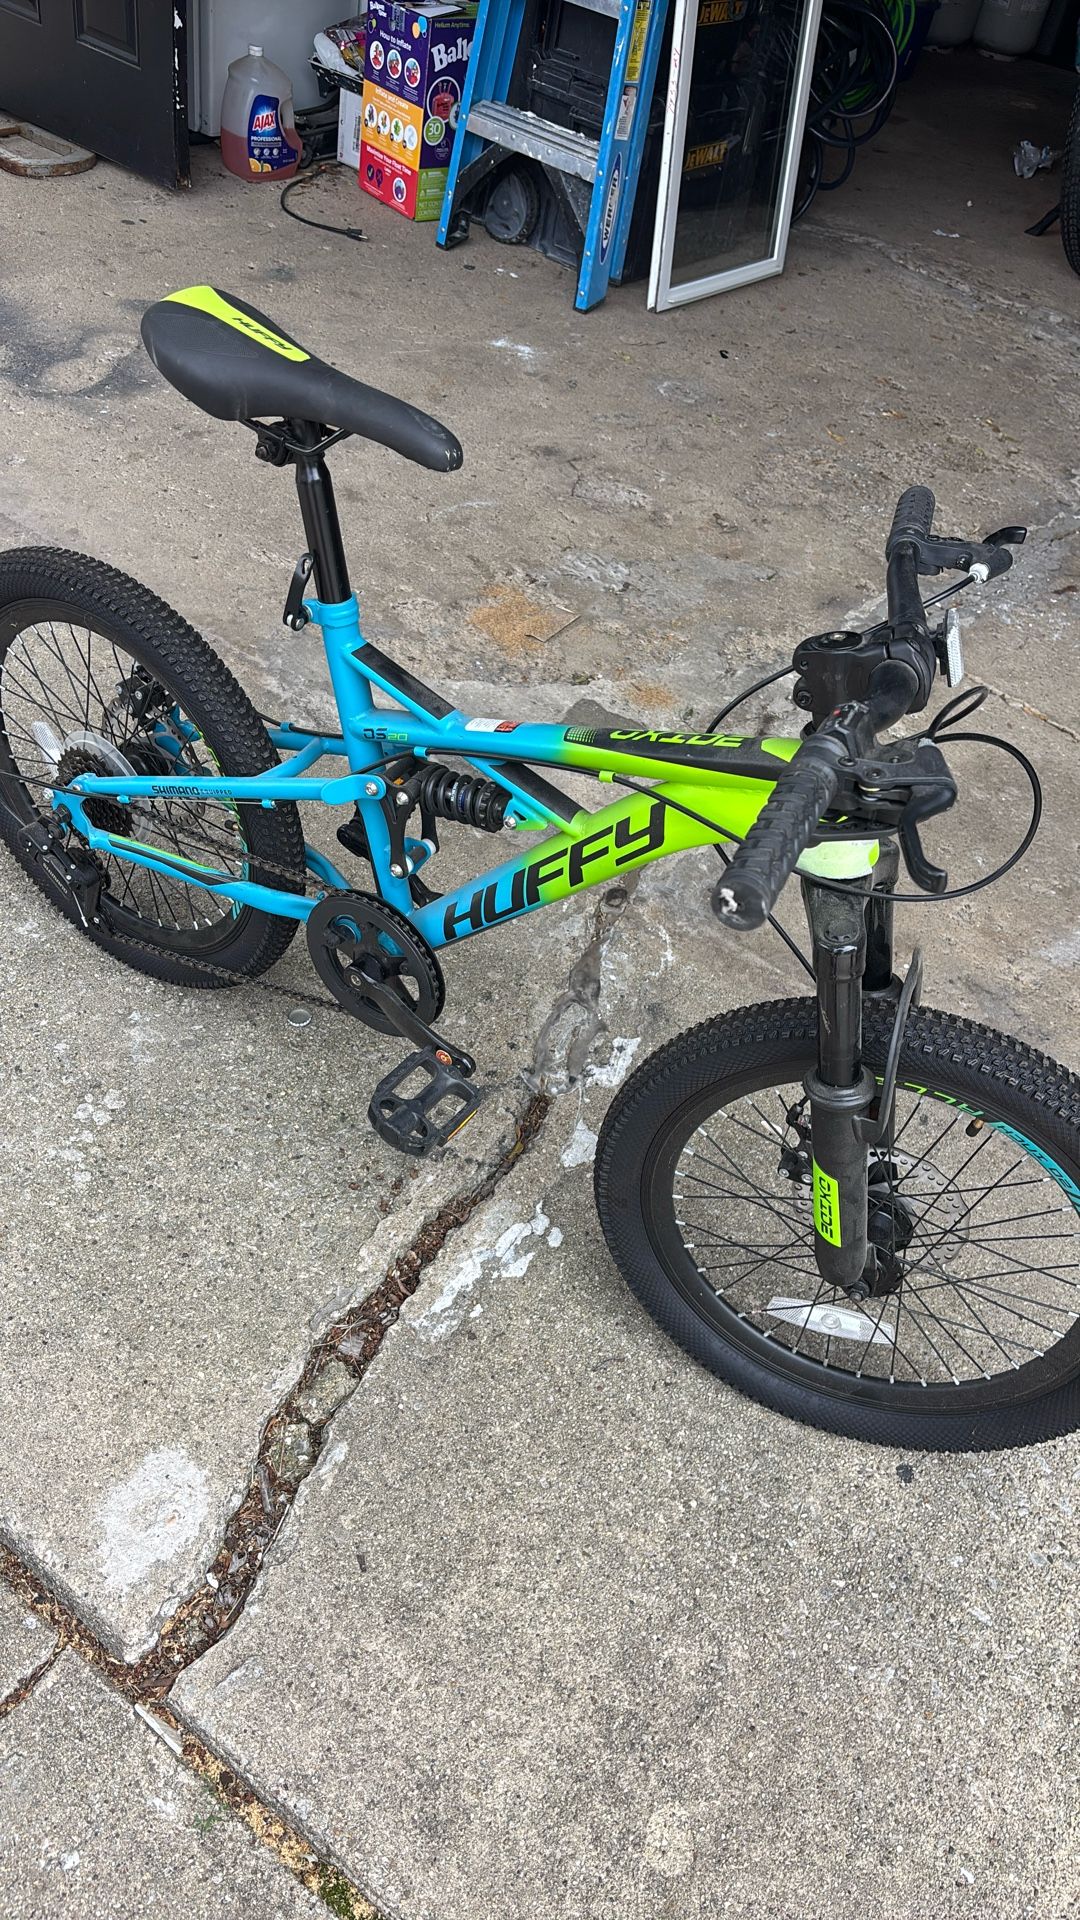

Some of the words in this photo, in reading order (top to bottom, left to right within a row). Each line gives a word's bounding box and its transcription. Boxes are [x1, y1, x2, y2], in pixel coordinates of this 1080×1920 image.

[697, 1, 743, 23] EWAT
[380, 30, 390, 40] How
[252, 110, 276, 133] AJAX
[428, 123, 441, 135] 30
[232, 317, 293, 351] HUFFY
[609, 729, 756, 748] OXIDE
[151, 785, 200, 796] SHIMANO
[443, 801, 666, 941] HUFFY
[997, 1125, 1049, 1163] INCH
[1051, 1167, 1073, 1189] 20
[818, 1176, 834, 1239] OXIDE
